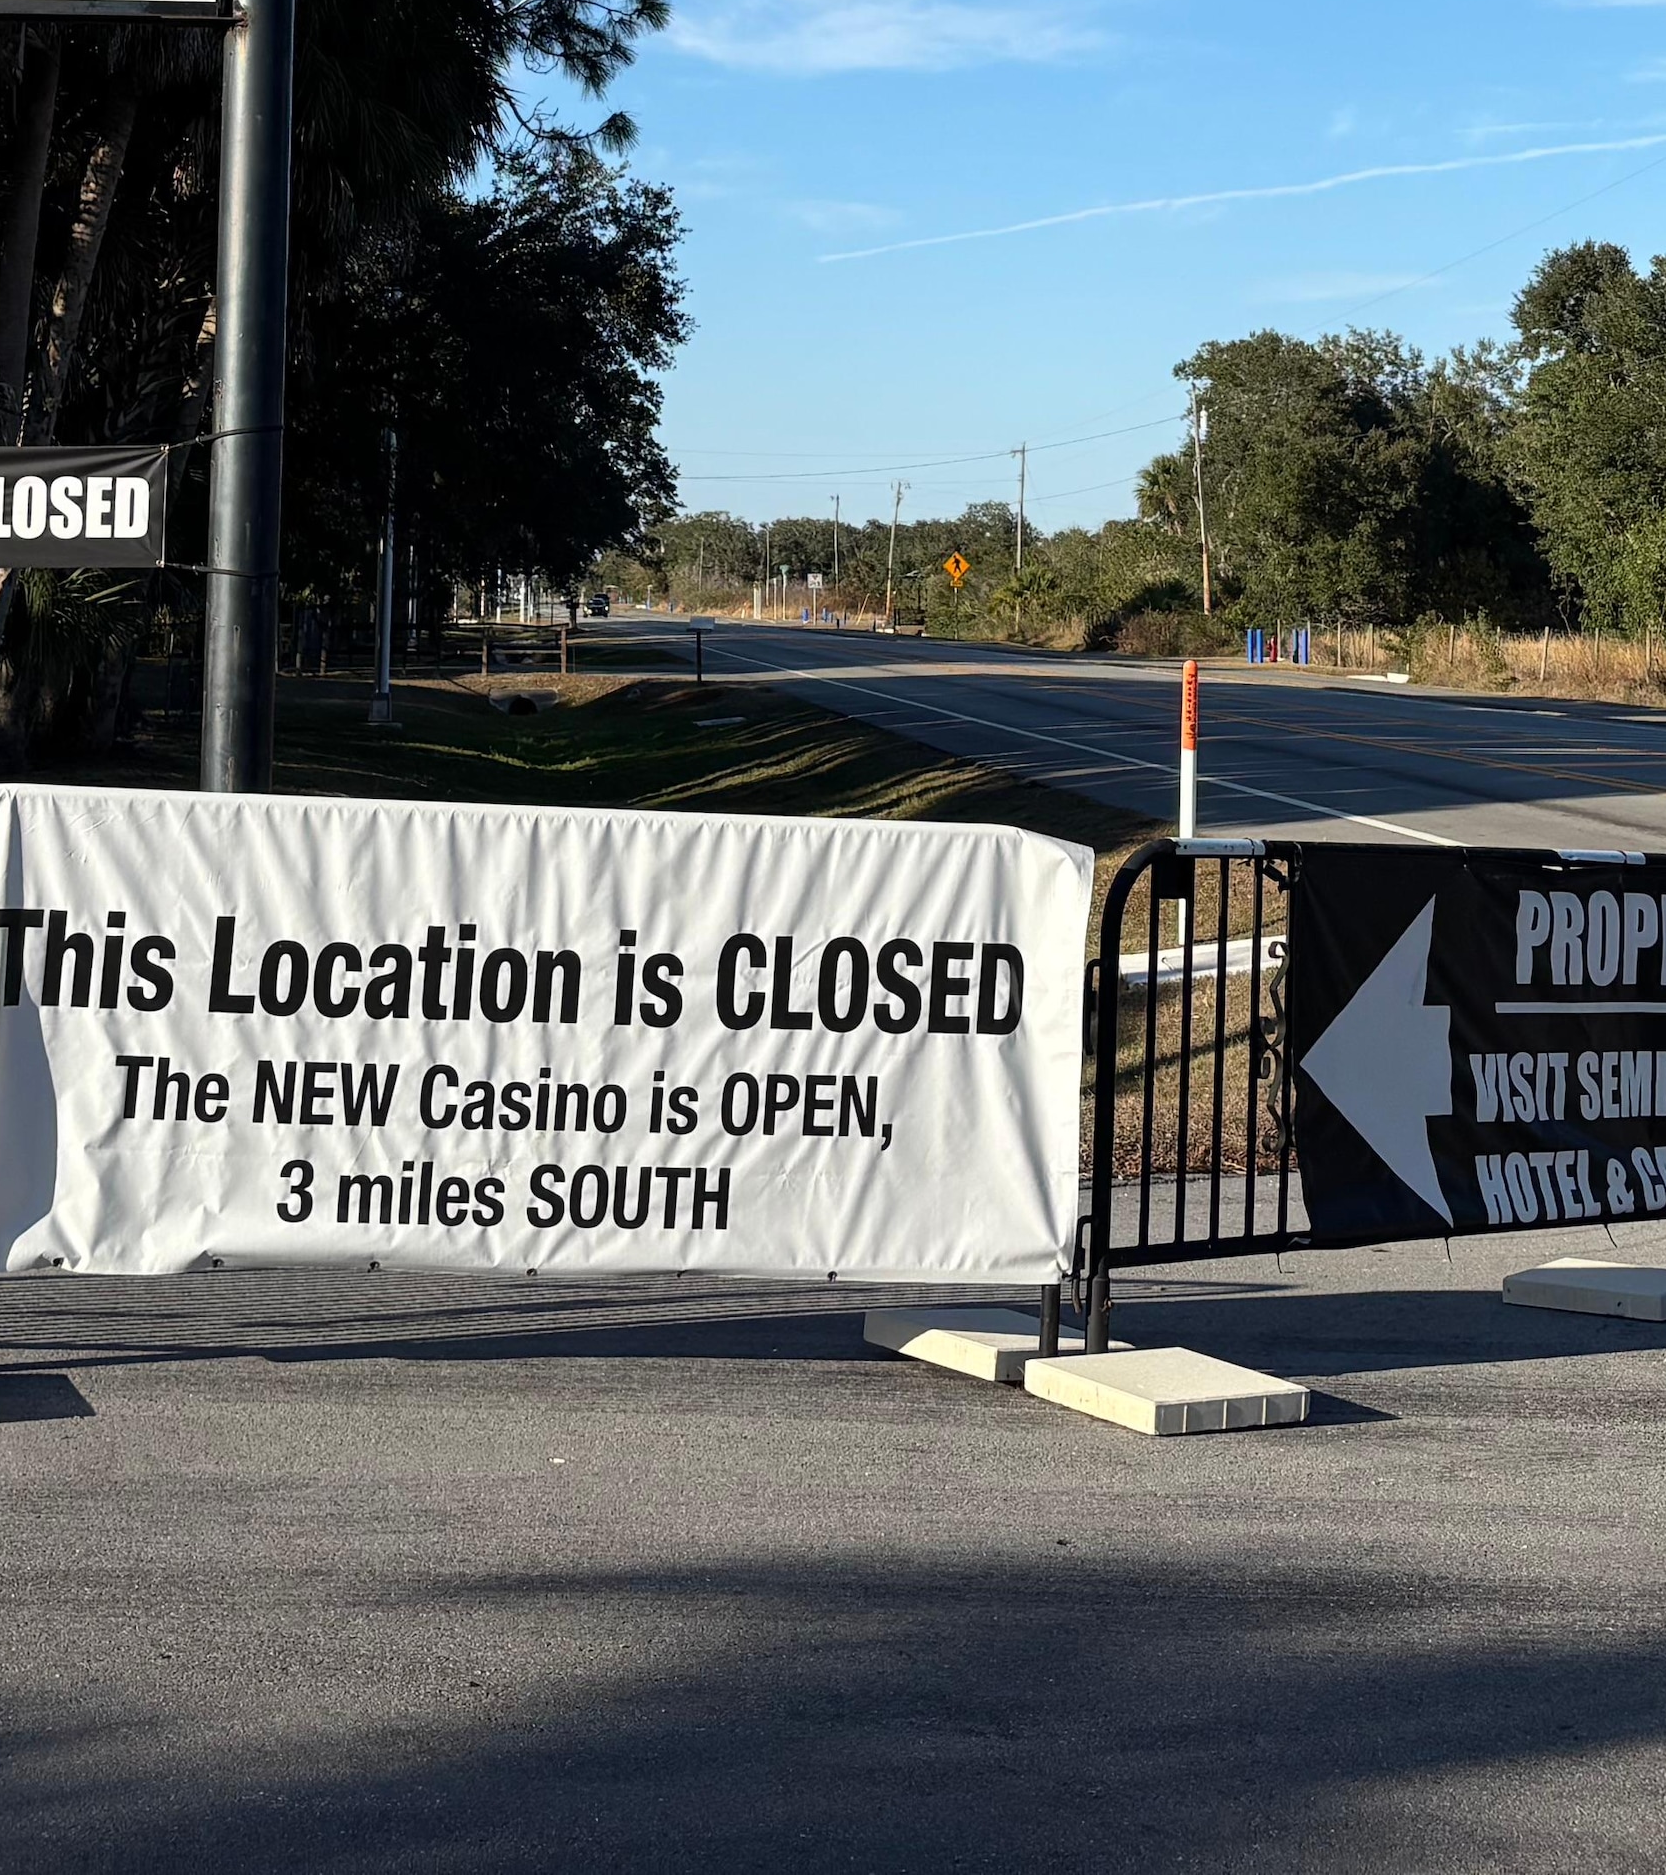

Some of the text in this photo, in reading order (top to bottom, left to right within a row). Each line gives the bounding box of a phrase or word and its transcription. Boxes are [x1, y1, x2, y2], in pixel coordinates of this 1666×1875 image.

[209, 917, 580, 1023] Location
[615, 930, 683, 1027] is
[717, 934, 1023, 1035] CLOSED
[116, 1056, 892, 1150] The NEW Casino is OPEN,
[1470, 1052, 1568, 1122] VISIT
[277, 1160, 730, 1229] 3 miles SOUTH
[1475, 1150, 1601, 1224] HOTEL
[1606, 1158, 1634, 1214] &
